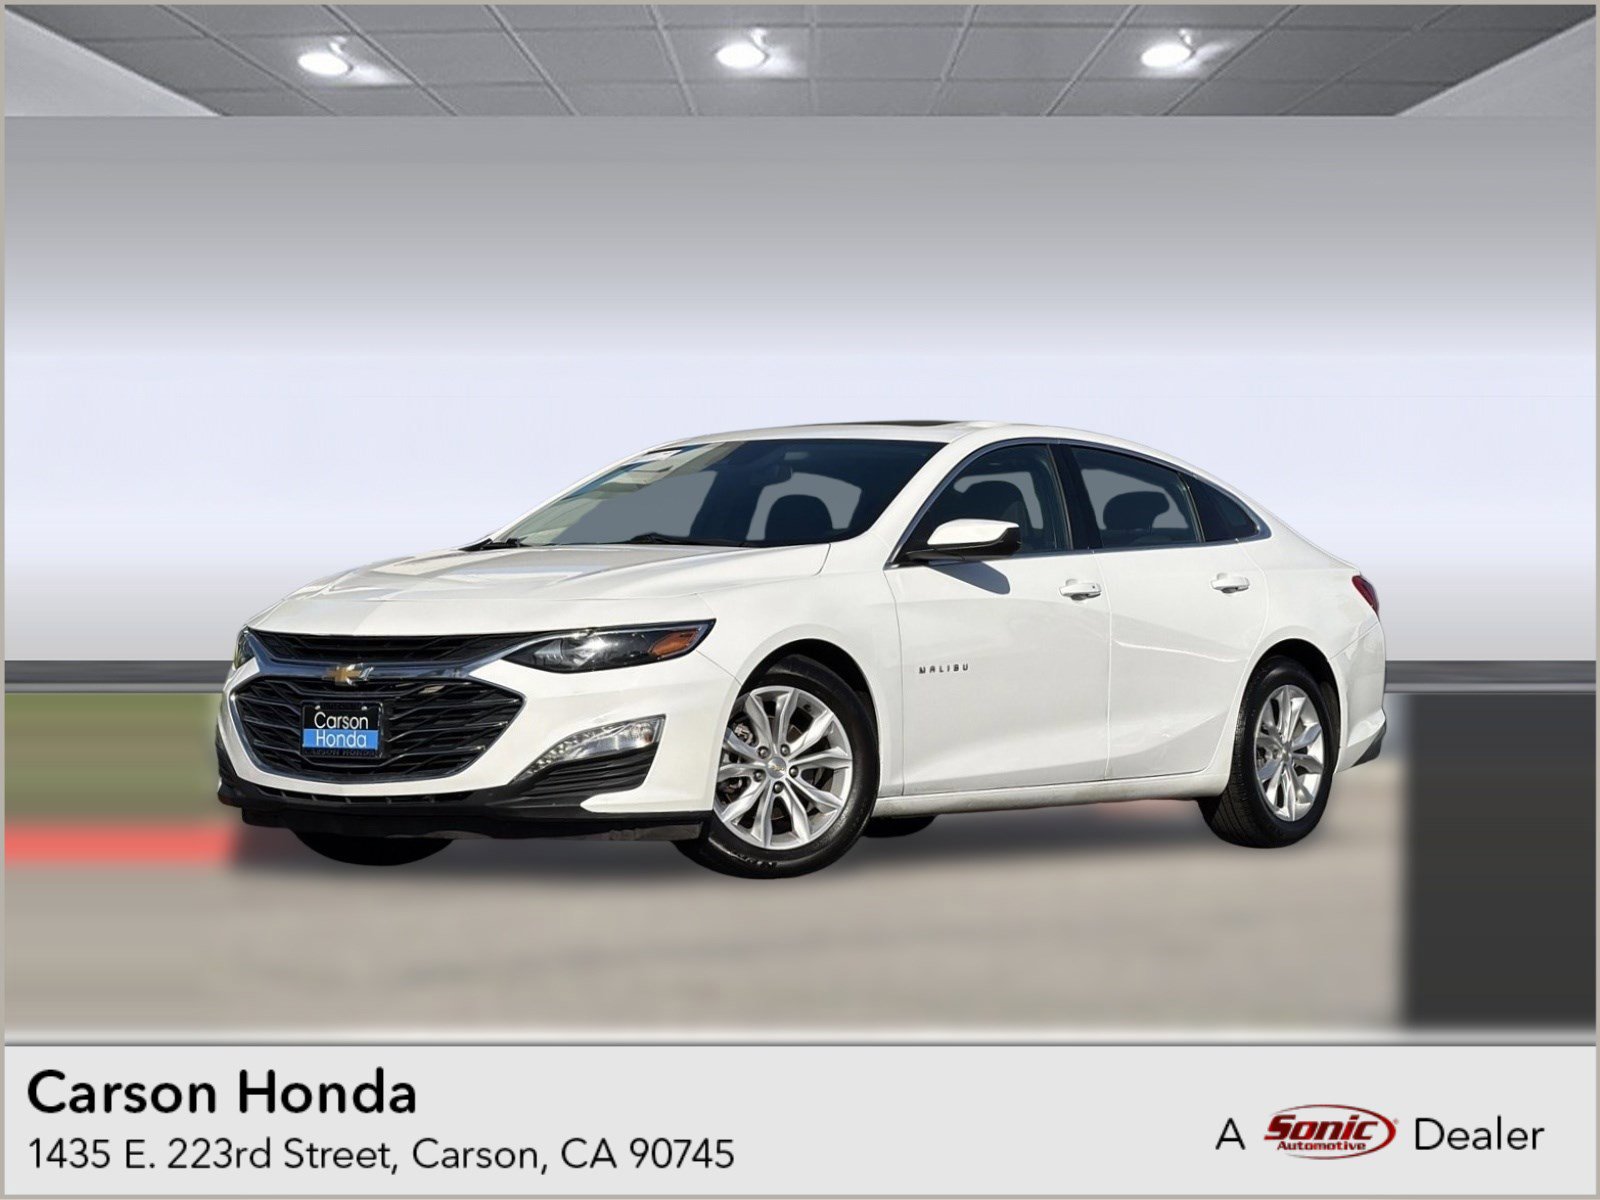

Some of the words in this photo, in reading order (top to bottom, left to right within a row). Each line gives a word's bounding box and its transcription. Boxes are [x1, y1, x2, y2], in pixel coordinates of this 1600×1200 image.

[919, 663, 969, 674] MALIBU
[314, 711, 369, 729] Carson
[316, 730, 367, 748] Honda
